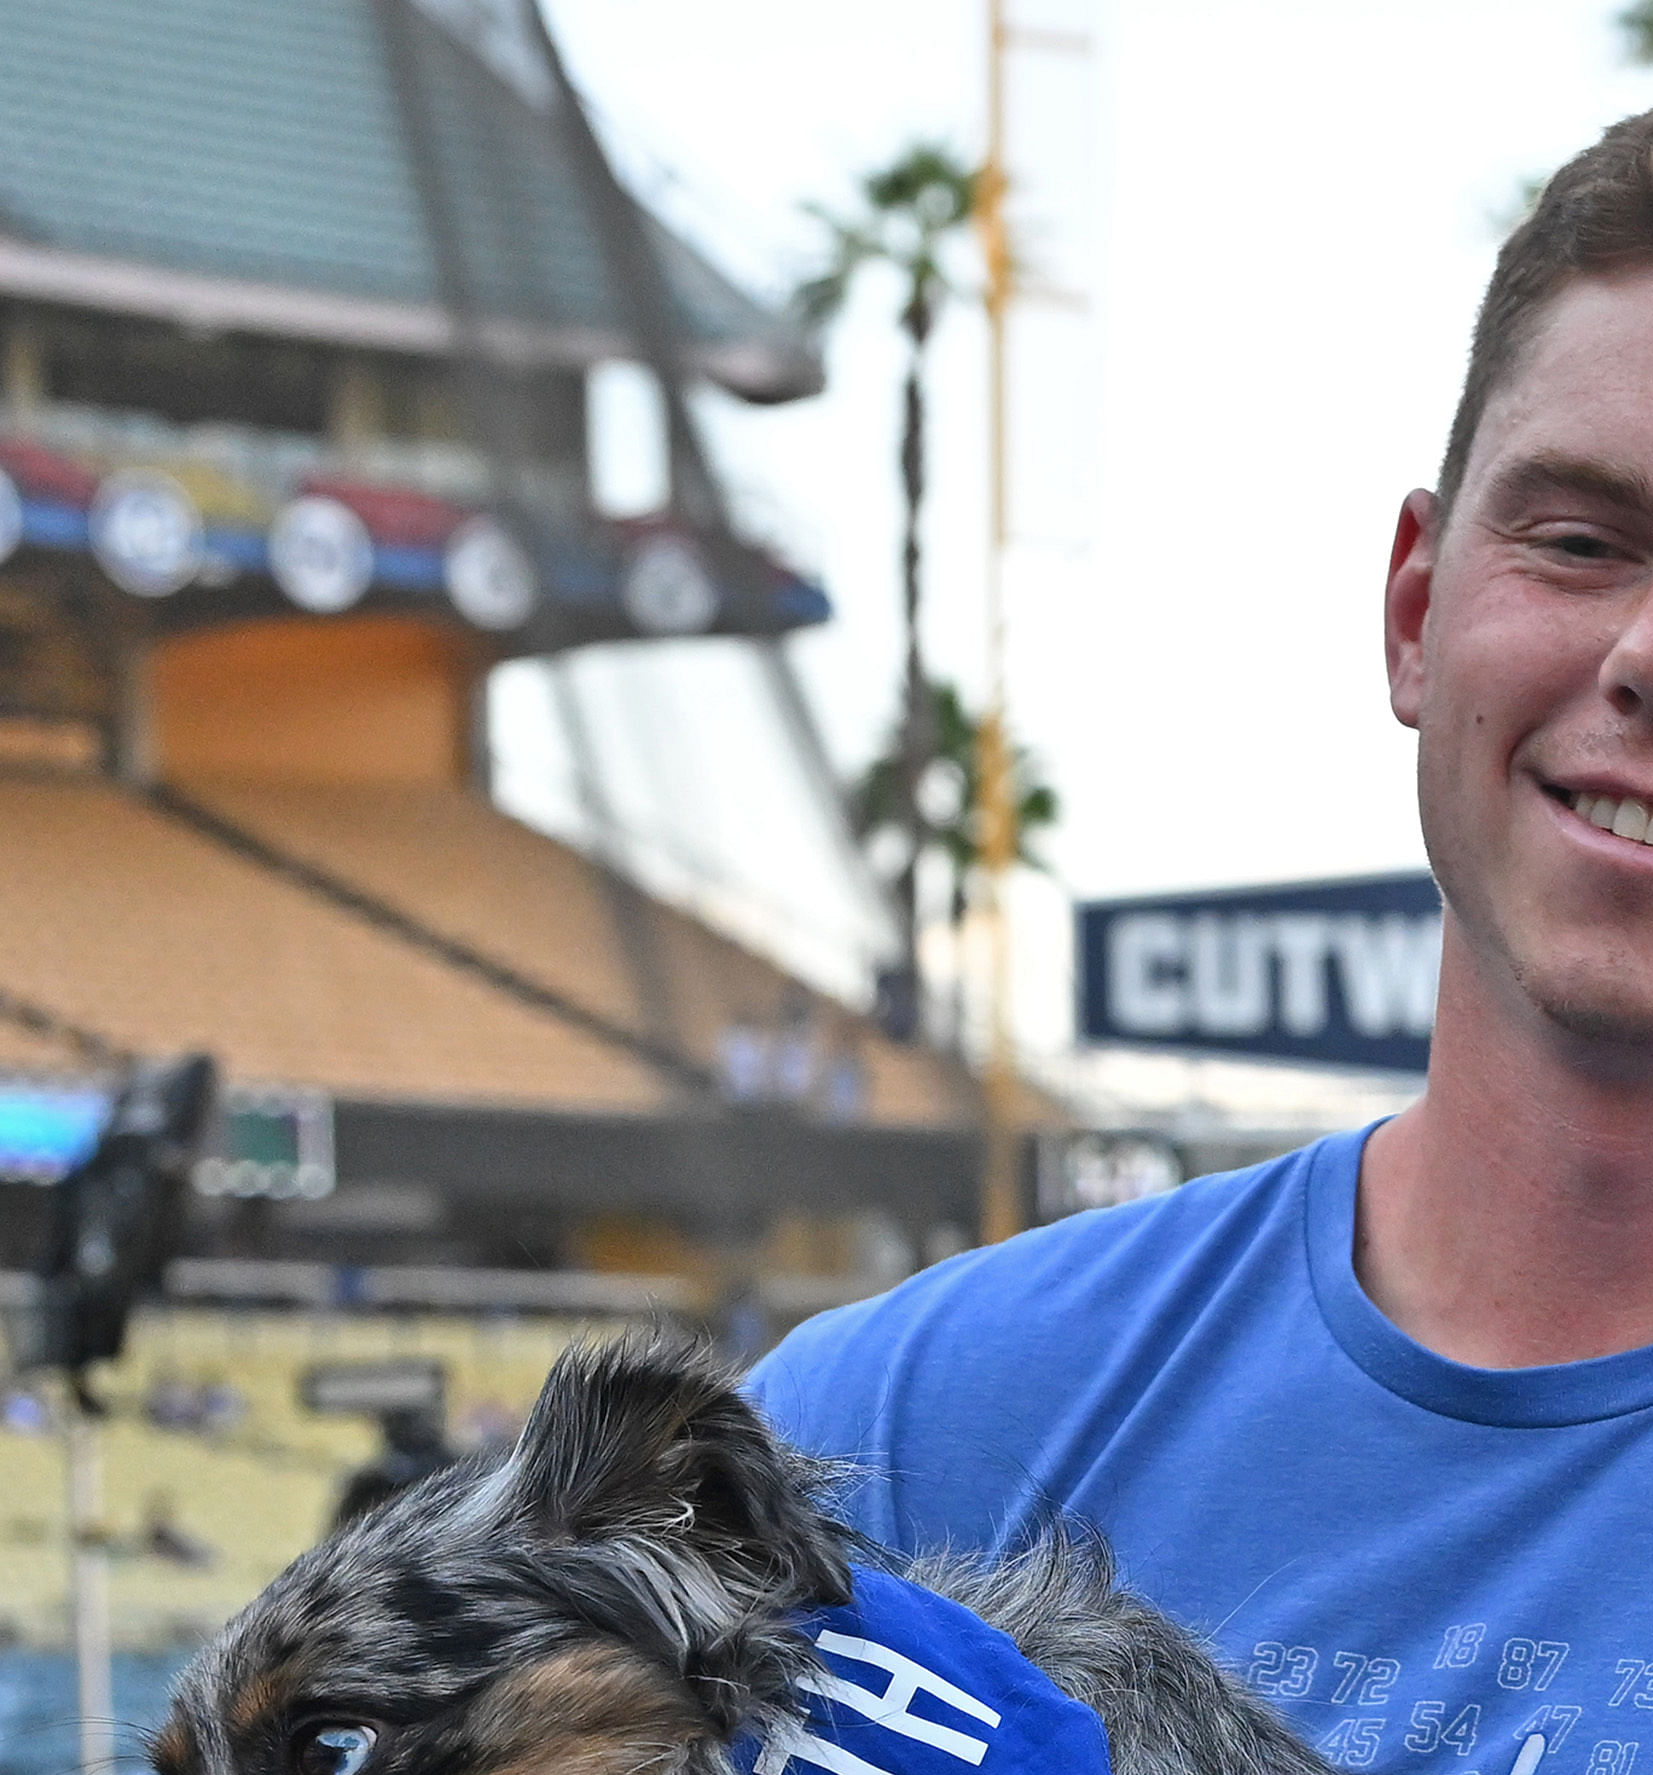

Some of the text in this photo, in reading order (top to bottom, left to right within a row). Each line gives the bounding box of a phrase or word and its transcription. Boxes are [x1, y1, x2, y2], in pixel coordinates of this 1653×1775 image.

[1107, 908, 1444, 1038] CUTW
[1248, 1641, 1400, 1706] 23 72
[1432, 1622, 1488, 1670] 18
[1497, 1638, 1570, 1692] 87
[1315, 1718, 1387, 1767] 45
[1404, 1700, 1482, 1757] 54
